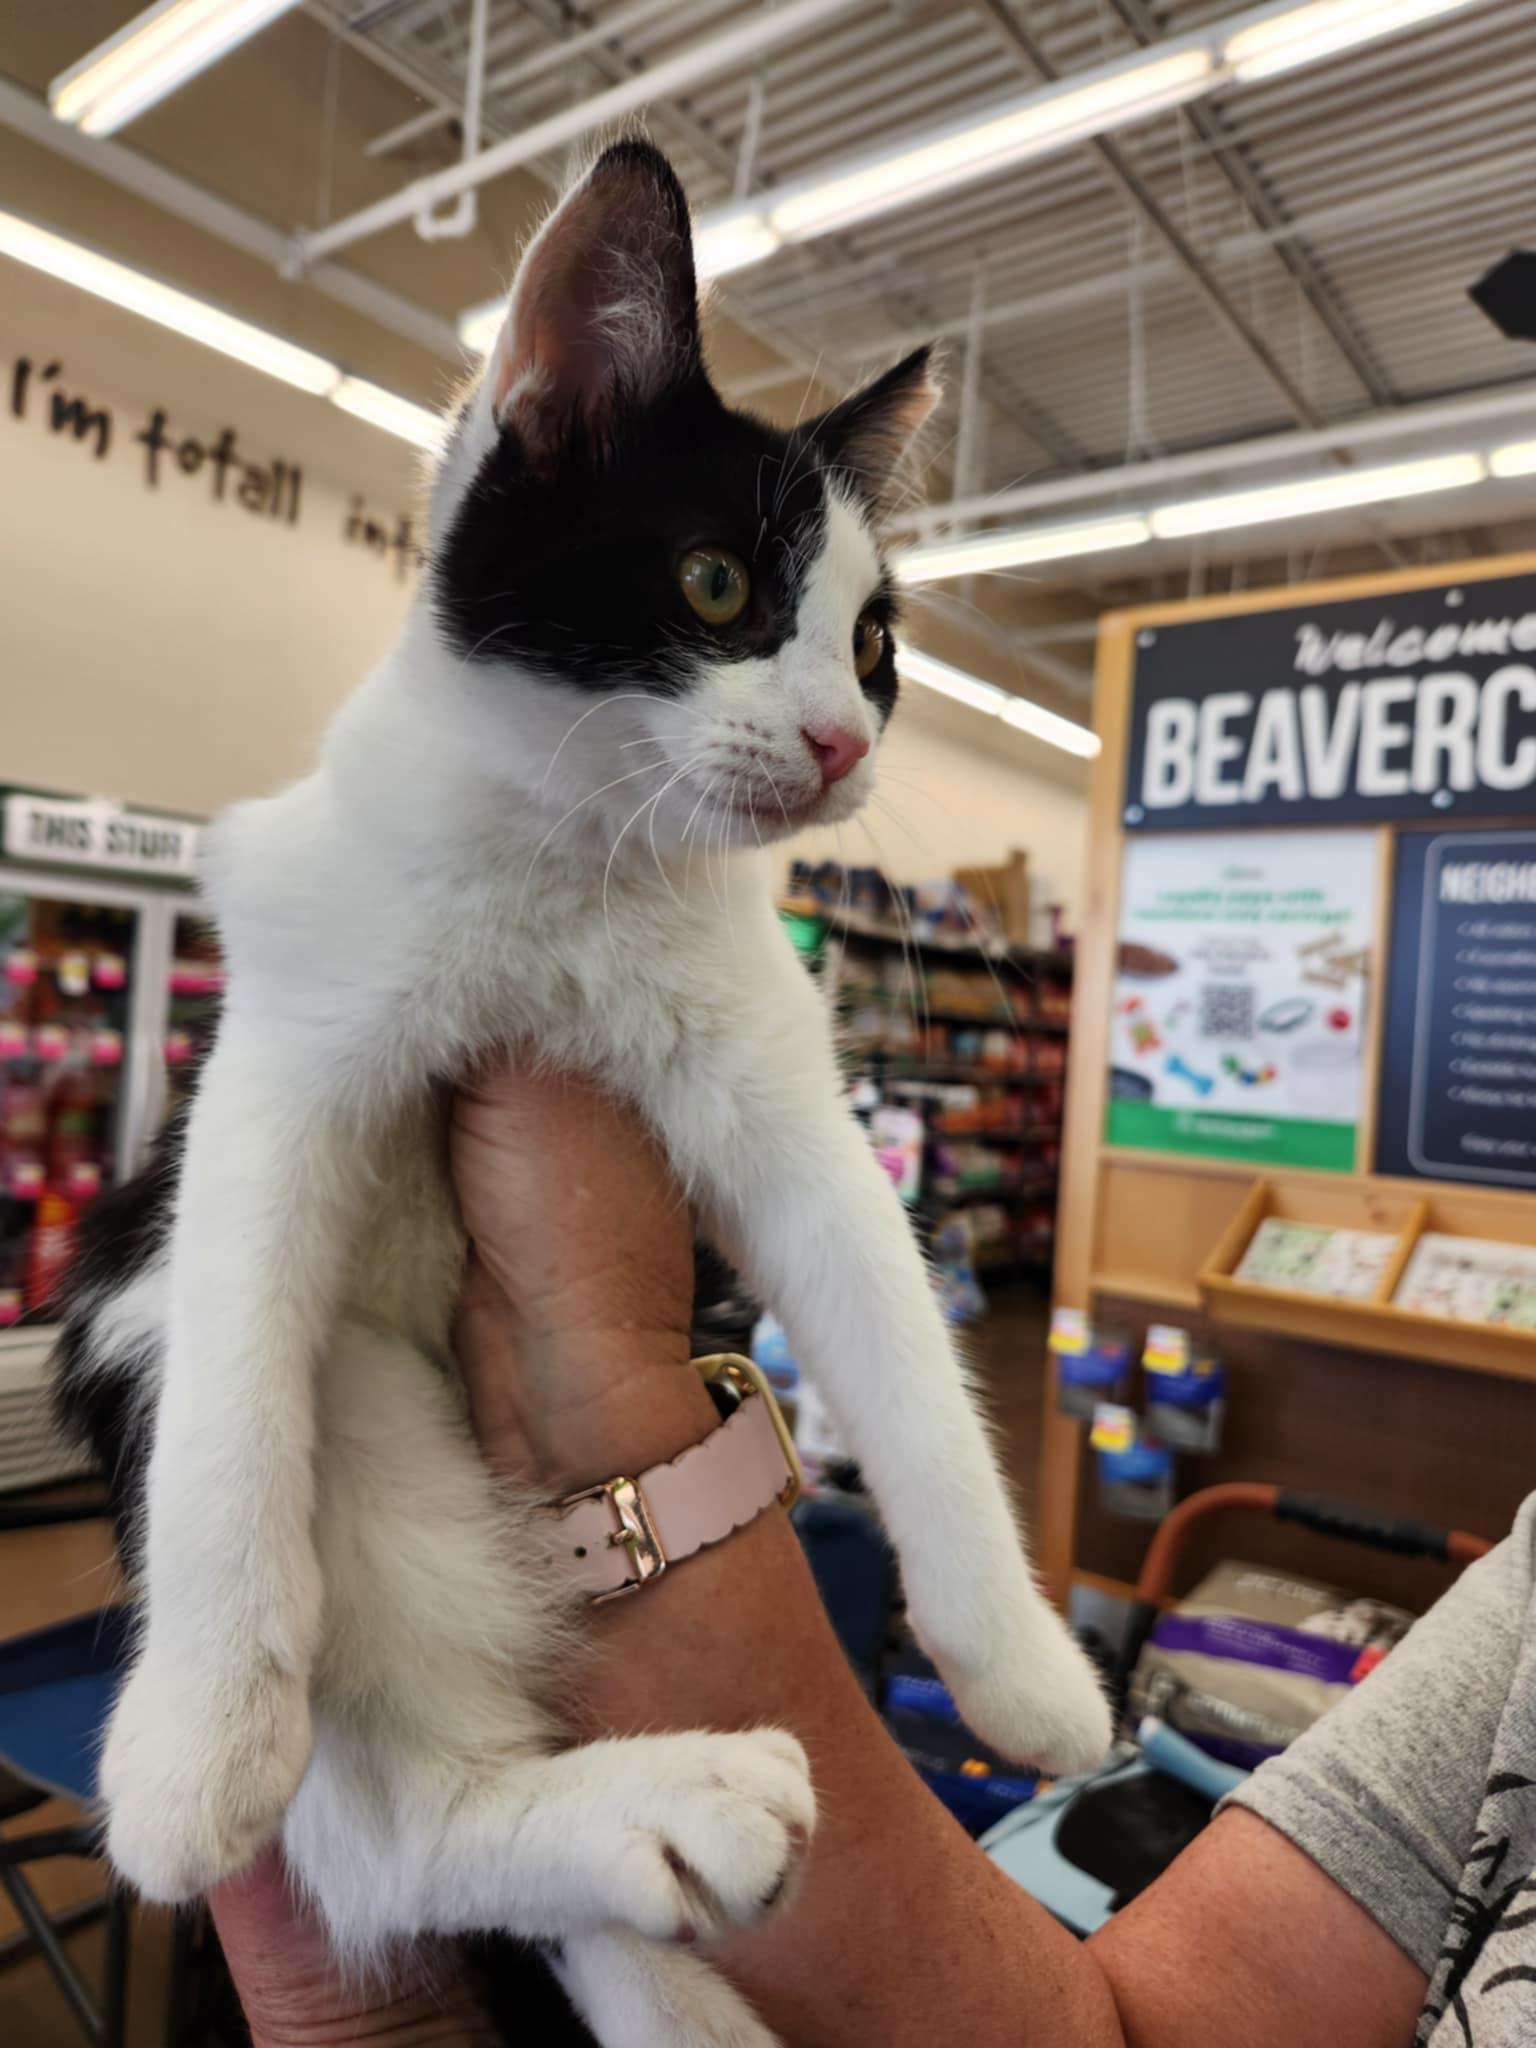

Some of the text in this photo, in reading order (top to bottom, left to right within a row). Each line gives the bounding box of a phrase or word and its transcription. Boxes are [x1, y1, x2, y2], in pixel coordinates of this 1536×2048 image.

[11, 357, 112, 460] I'm
[1142, 664, 1536, 809] BEAVERC
[29, 809, 91, 850] THIS
